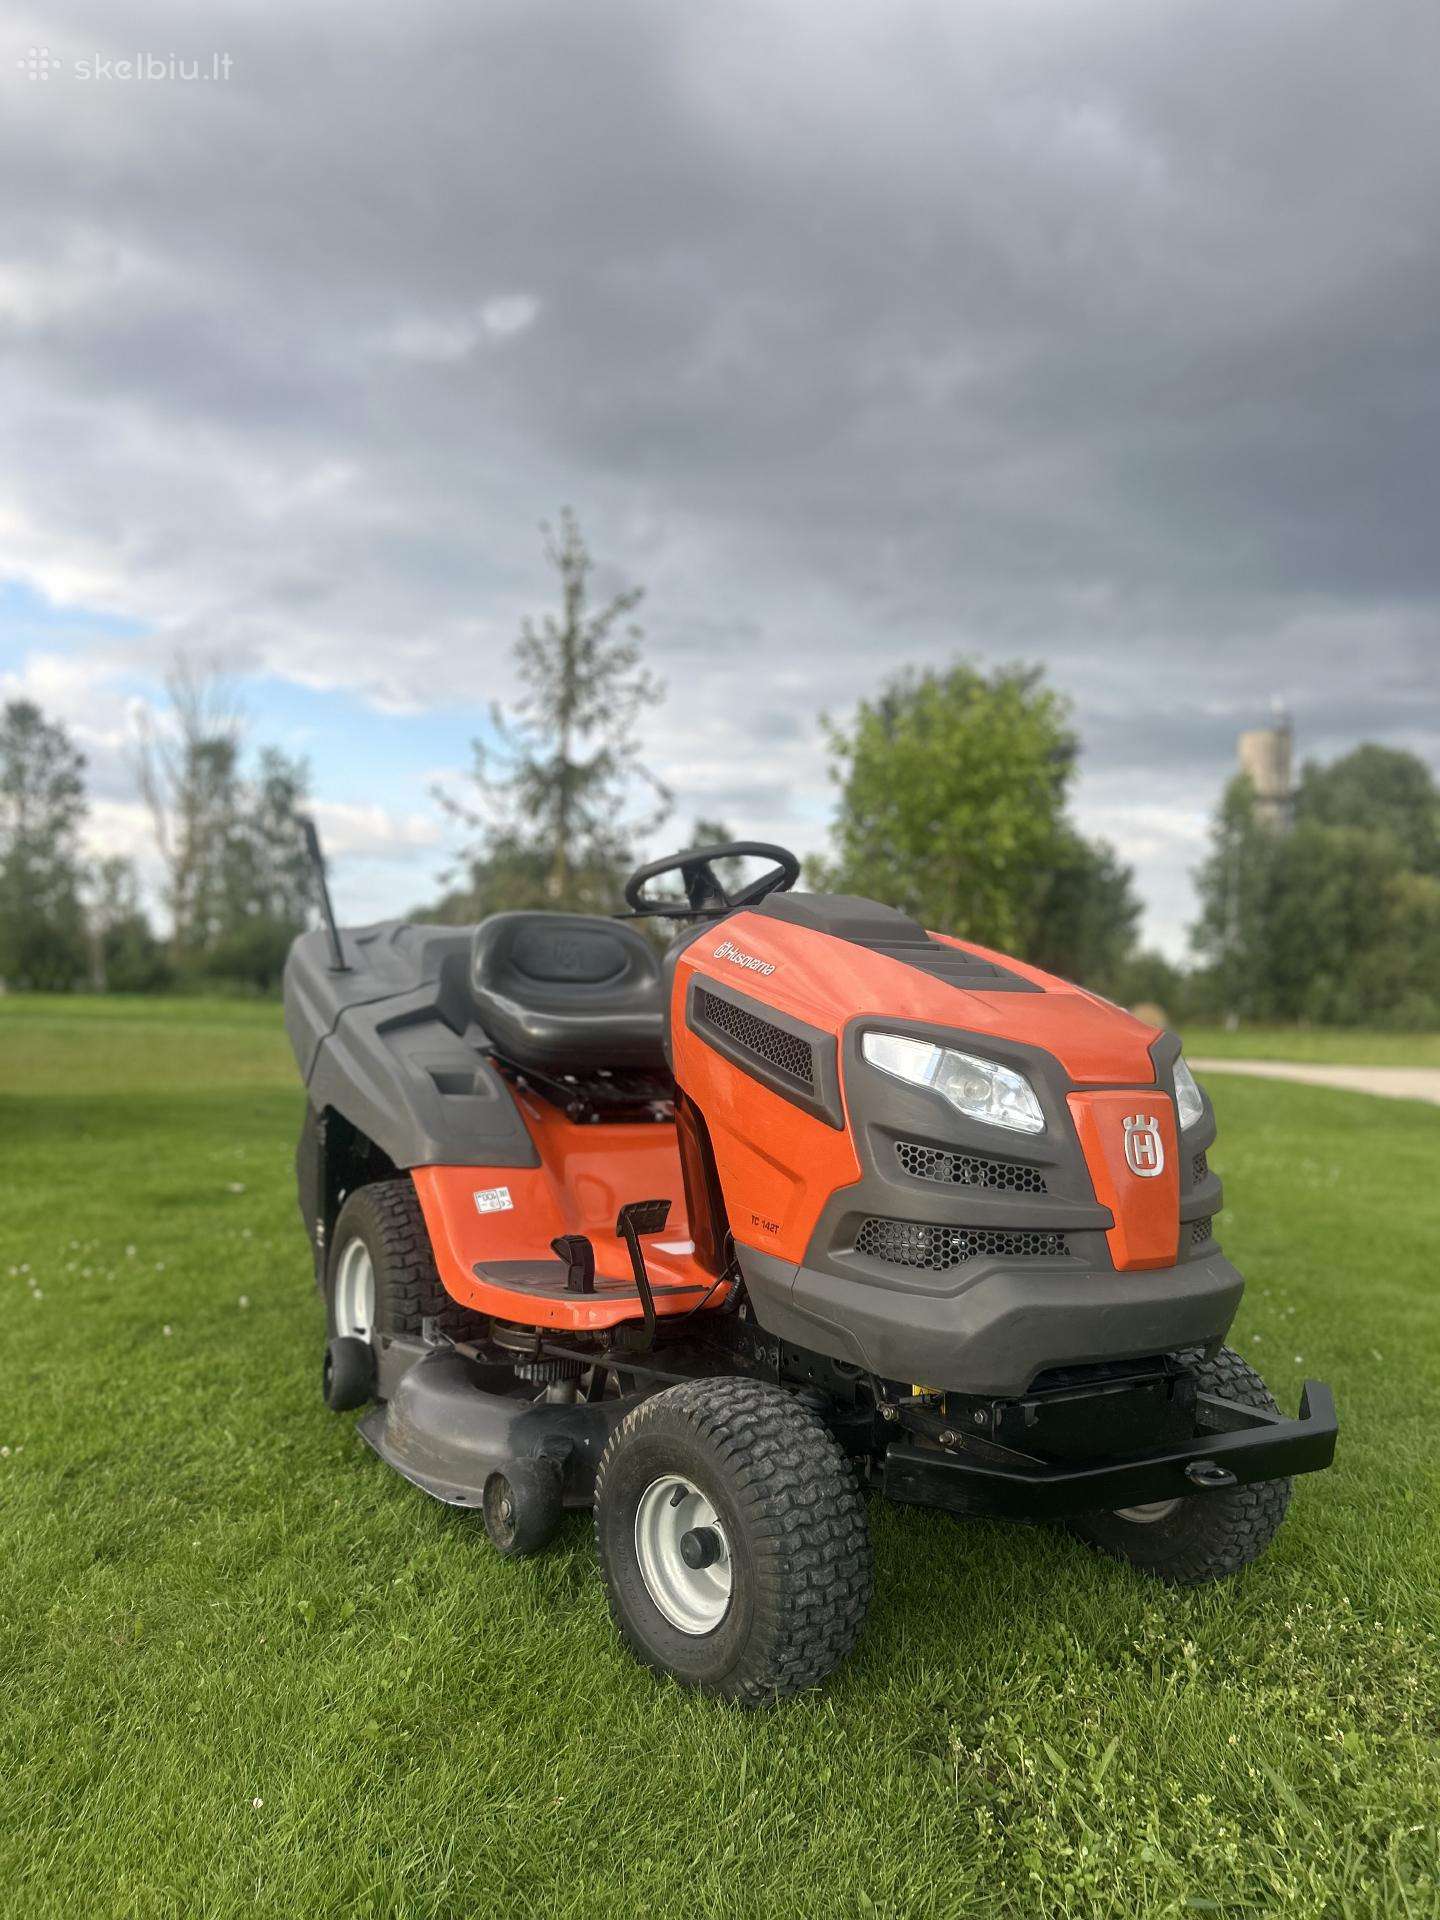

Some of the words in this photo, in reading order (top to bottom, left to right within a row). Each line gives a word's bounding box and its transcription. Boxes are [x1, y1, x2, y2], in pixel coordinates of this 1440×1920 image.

[726, 946, 776, 975] Husqvarna
[752, 1215, 760, 1226] TC
[762, 1220, 780, 1235] 142T
